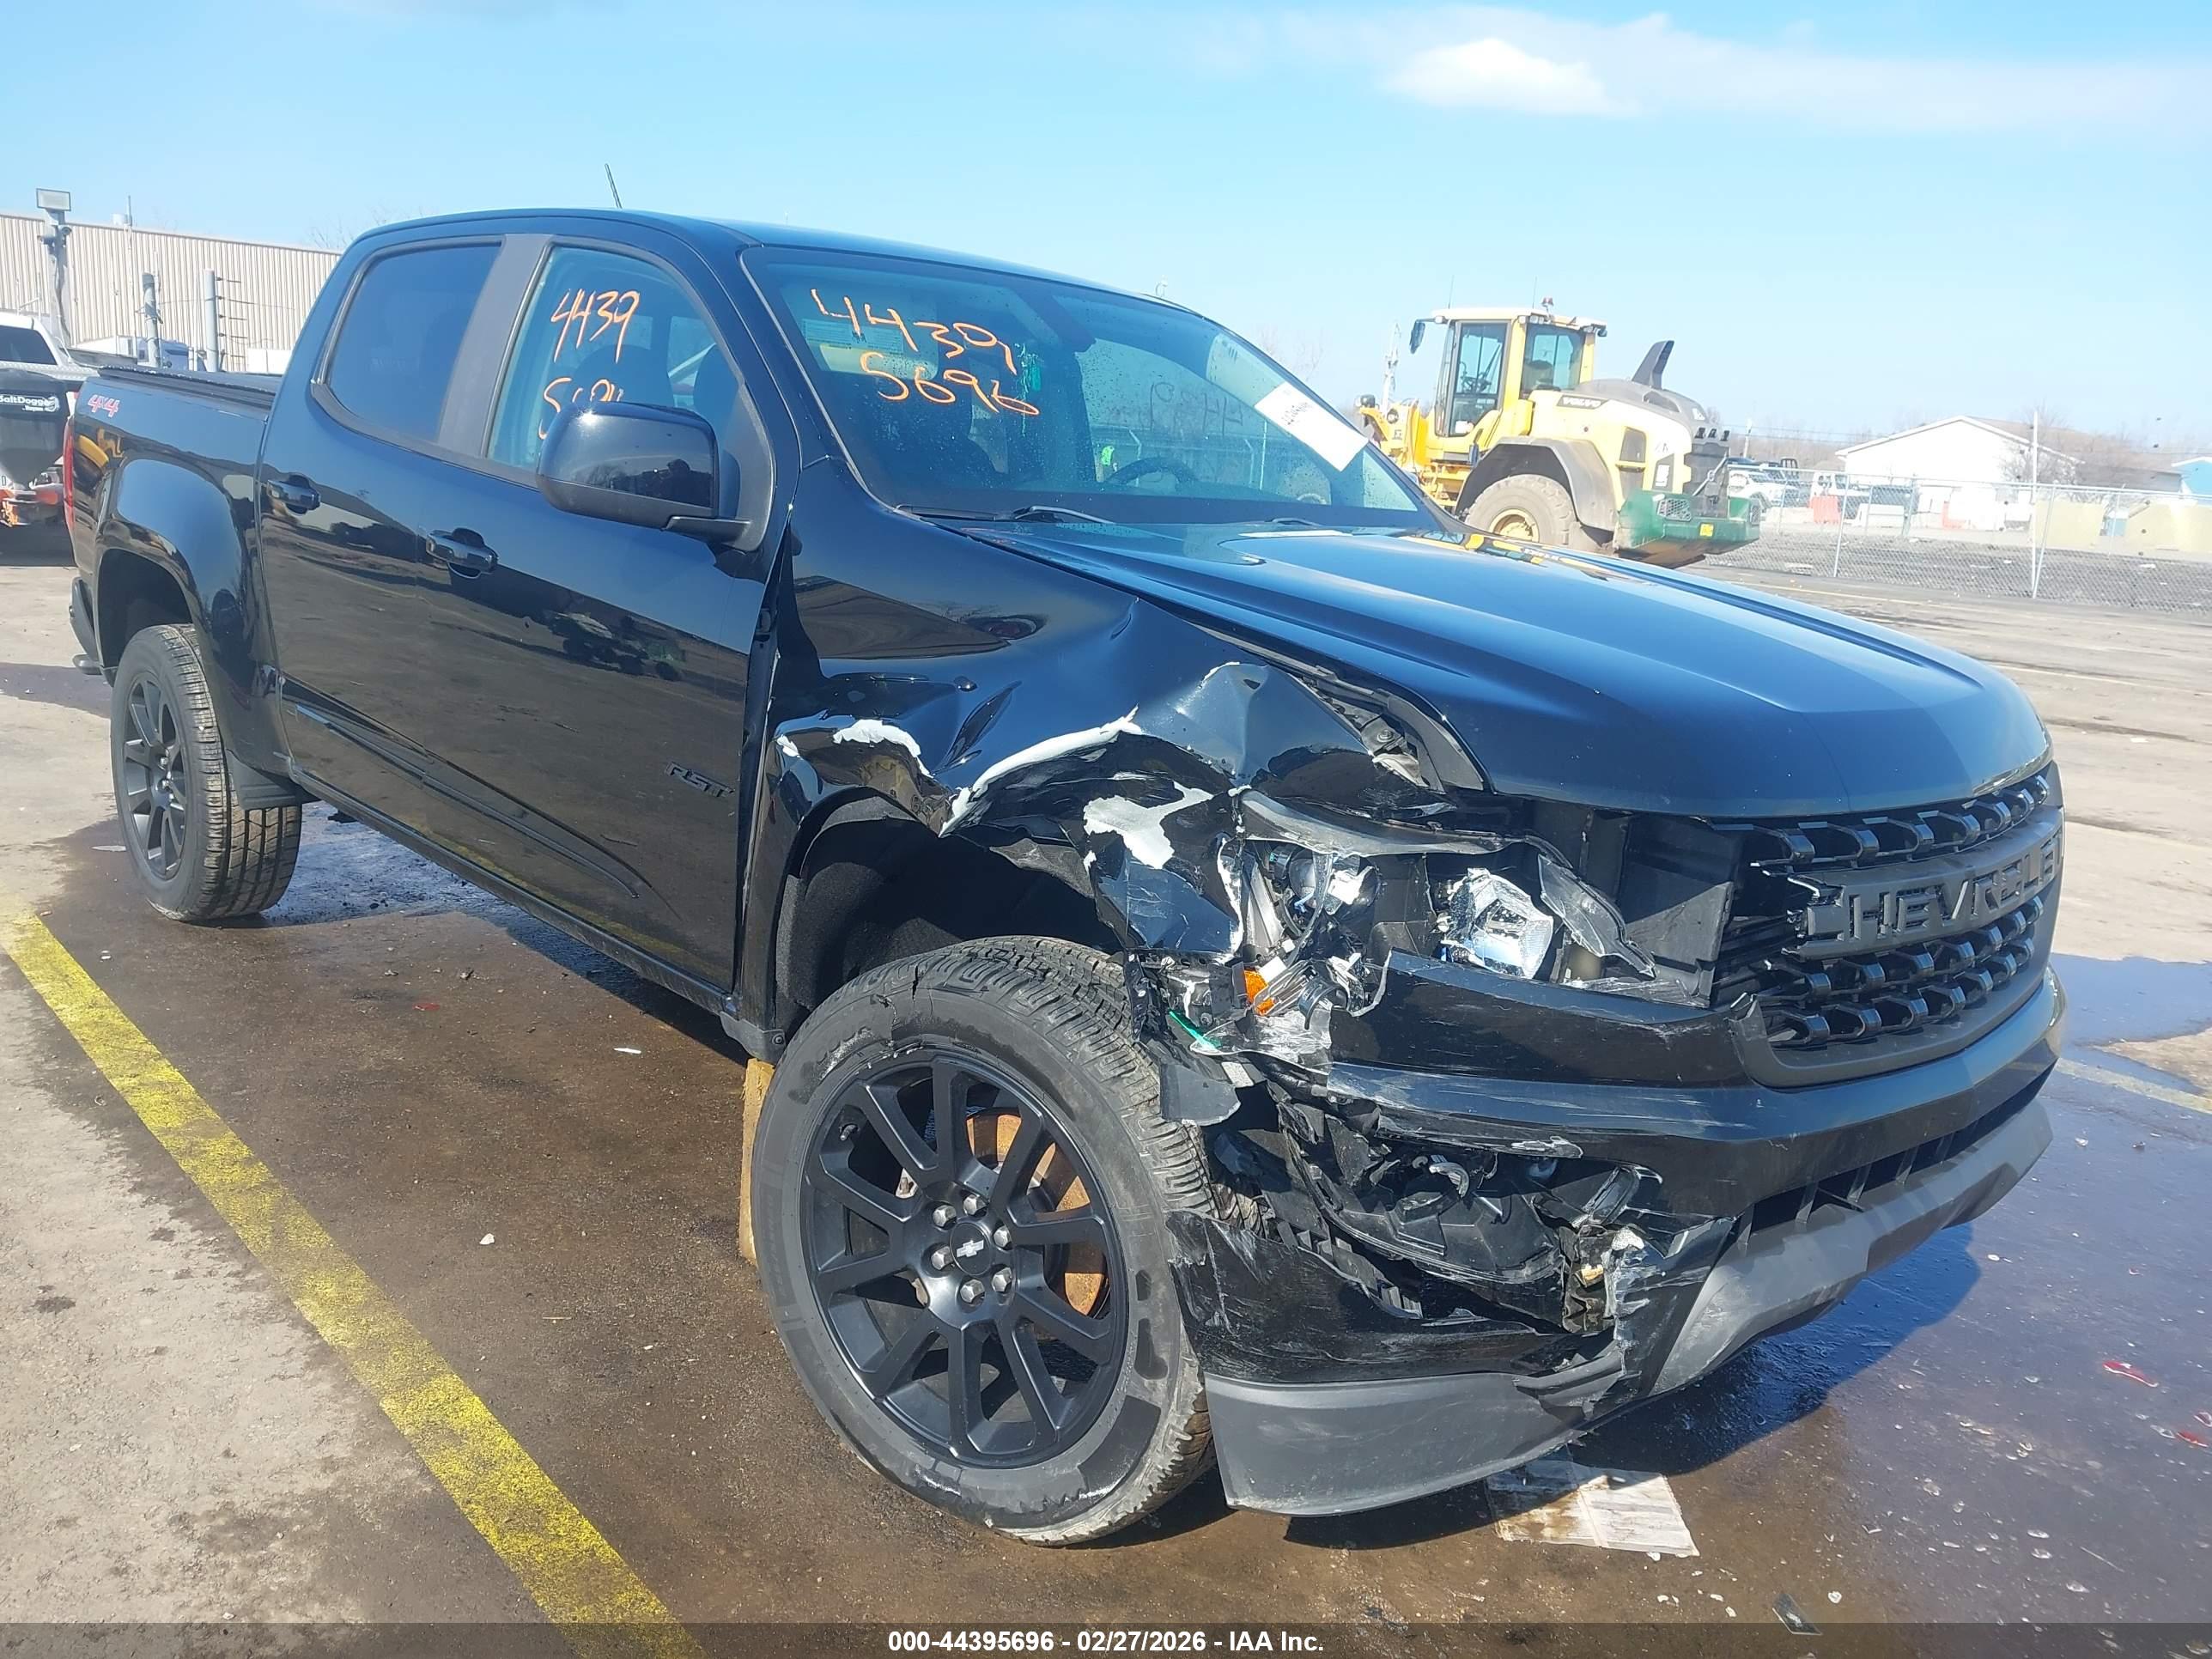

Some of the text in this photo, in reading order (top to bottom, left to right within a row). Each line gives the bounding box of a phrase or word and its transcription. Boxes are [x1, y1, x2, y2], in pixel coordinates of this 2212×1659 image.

[550, 288, 640, 364] 4439
[811, 289, 1018, 375] 4439
[860, 351, 1040, 416] 5696
[665, 761, 736, 798] RST
